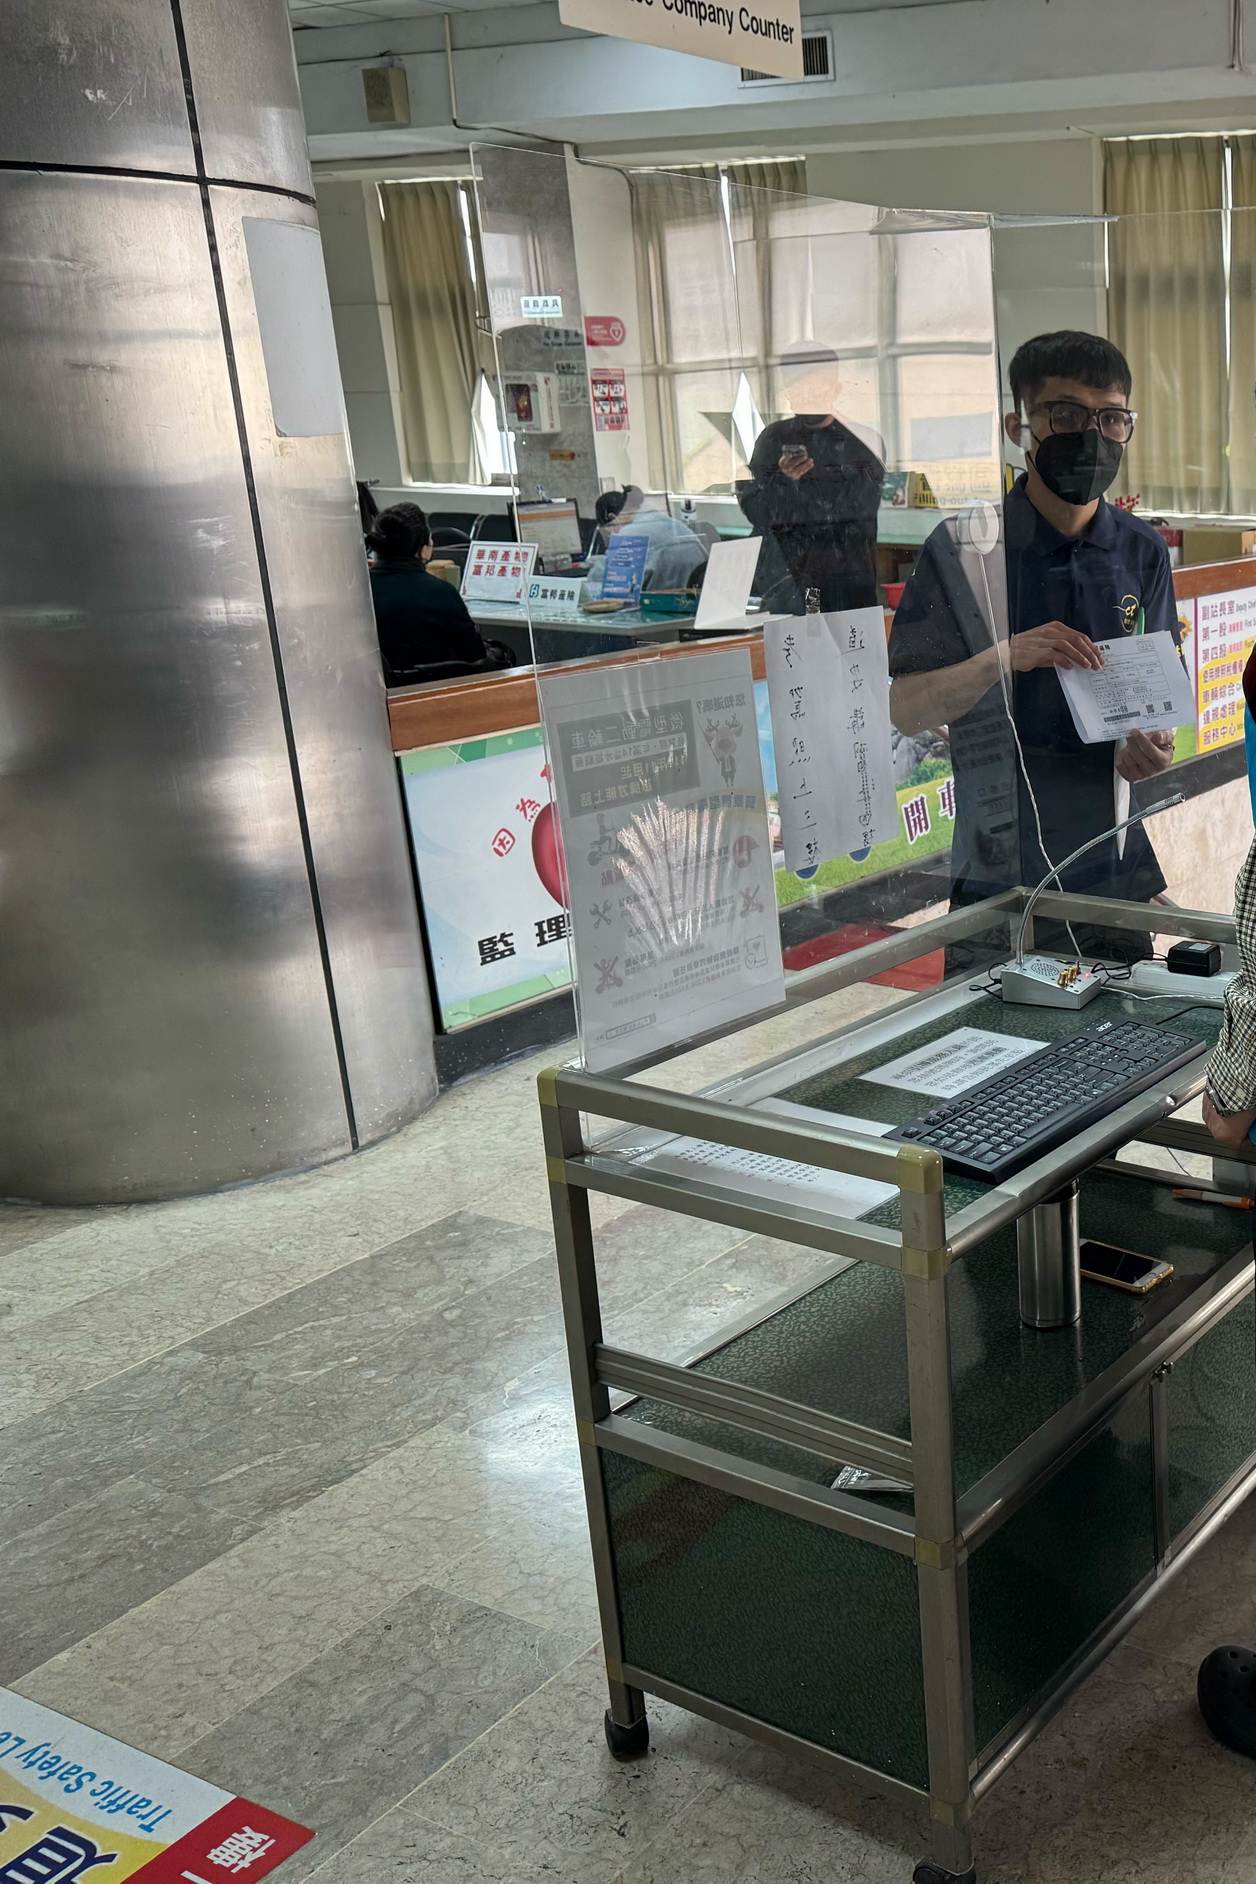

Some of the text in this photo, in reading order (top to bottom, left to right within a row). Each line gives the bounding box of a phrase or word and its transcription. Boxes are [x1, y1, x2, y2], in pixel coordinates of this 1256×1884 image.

[662, 0, 794, 44] Company Counter
[475, 549, 529, 563] 華南產物
[472, 564, 526, 578] 富邦產物
[540, 588, 575, 601] 富邦產險
[1202, 622, 1226, 641] 第一股
[17, 1742, 97, 1794] Safety
[90, 1780, 173, 1833] Traffic
